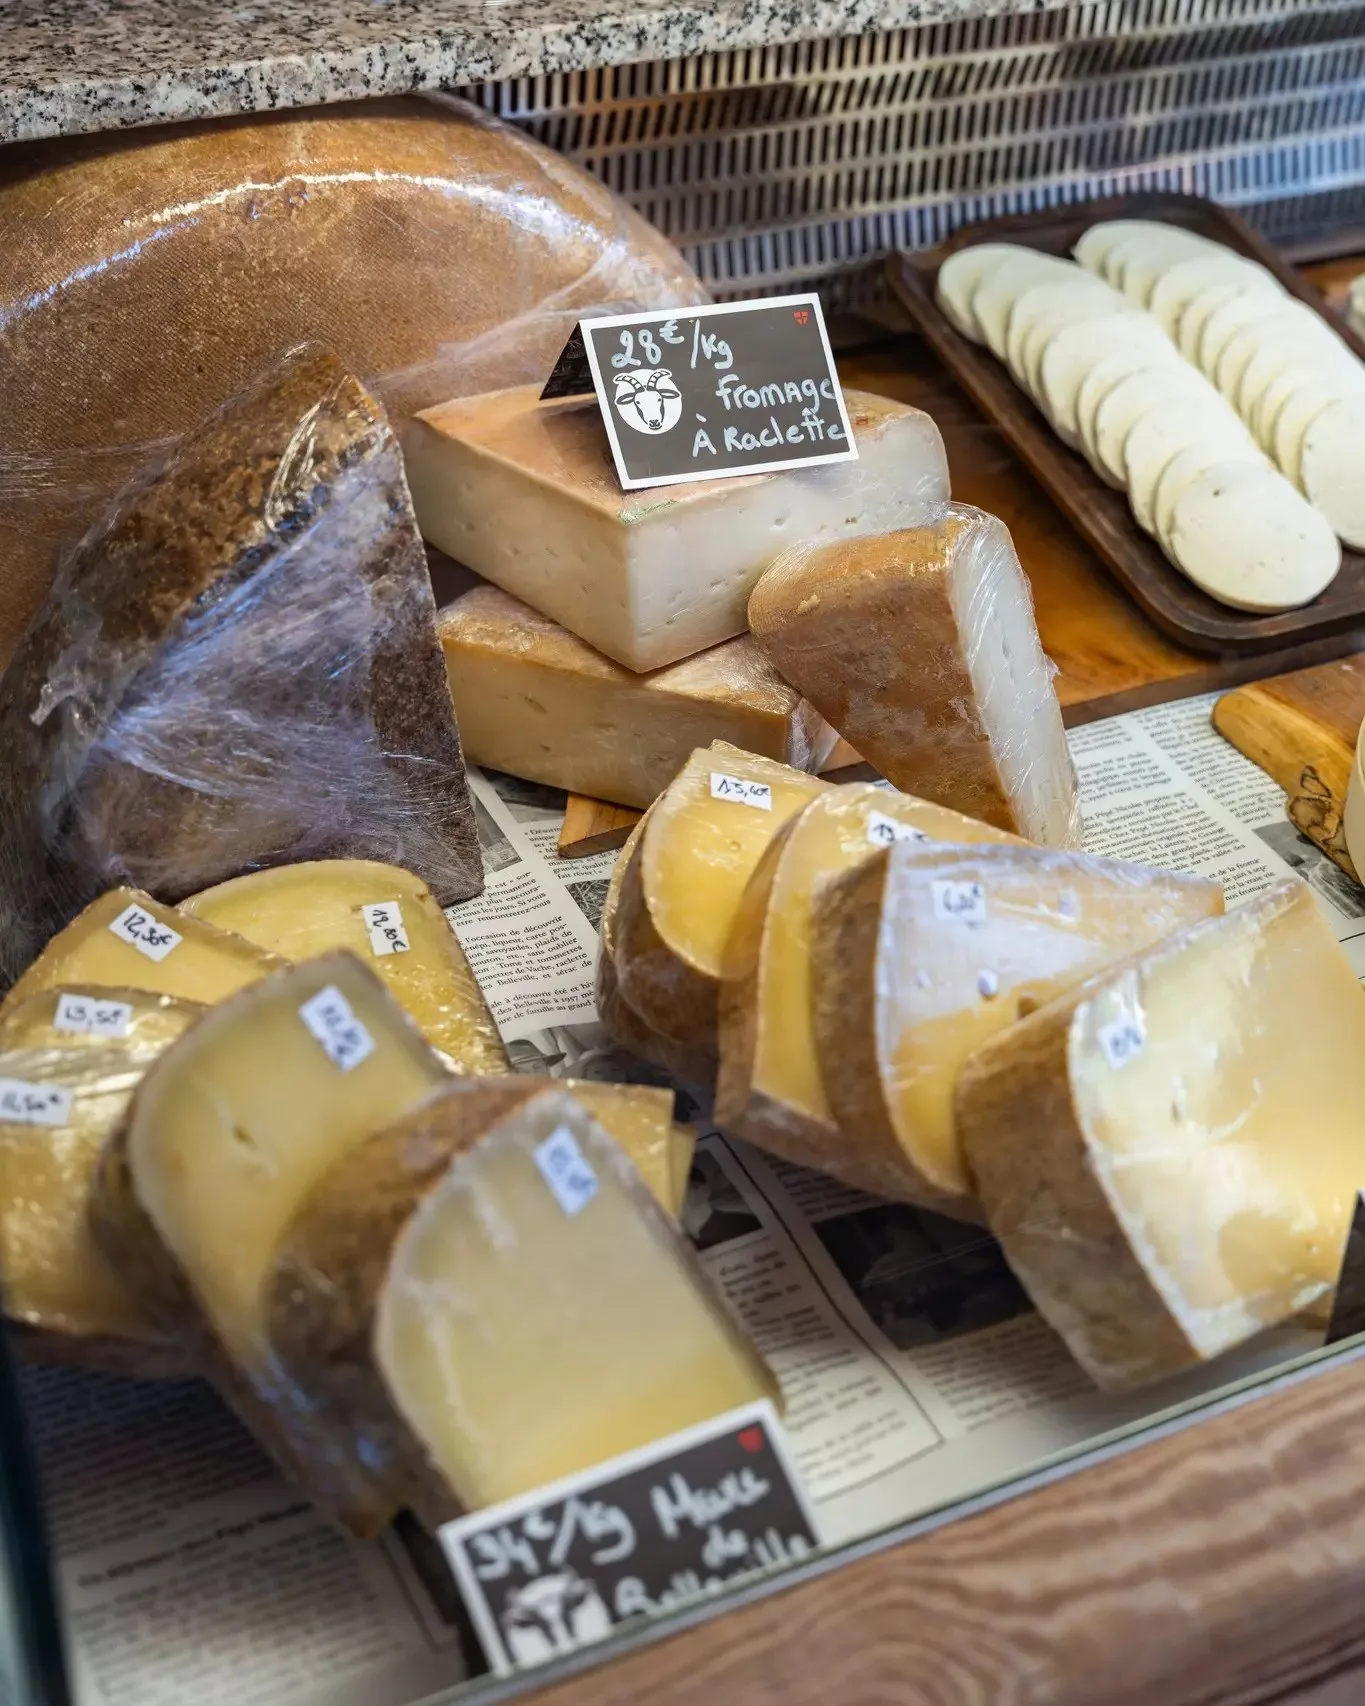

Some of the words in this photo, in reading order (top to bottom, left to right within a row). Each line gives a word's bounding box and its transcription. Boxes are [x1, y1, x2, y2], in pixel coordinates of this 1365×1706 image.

[723, 406, 847, 452] Raclette
[487, 878, 537, 899] permanence
[1224, 893, 1239, 901] nos
[451, 905, 470, 915] plus
[486, 897, 504, 907] plus
[462, 909, 482, 918] tous
[481, 906, 494, 914] les
[494, 903, 517, 913] jours.
[517, 899, 527, 907] Si
[526, 892, 547, 904] vous
[456, 918, 474, 927] être
[523, 915, 563, 934] découvrir
[464, 943, 491, 953] énépi,
[491, 937, 524, 948] liqueur,
[525, 931, 547, 942] carte
[467, 951, 483, 960] ion
[485, 944, 533, 956] savoyardes,
[534, 935, 560, 949] plaids
[561, 930, 573, 938] de
[527, 949, 545, 957] sans
[547, 937, 578, 953] oublier
[536, 944, 583, 964] tommettes
[478, 970, 514, 983] omettes
[514, 967, 525, 975] de
[526, 963, 555, 973] Vache,
[555, 952, 588, 968] raclette
[497, 974, 539, 986] Belleville,
[555, 965, 578, 977] sérac
[581, 959, 593, 968] de
[513, 990, 552, 1002] découvrir
[554, 988, 568, 996] été
[513, 998, 552, 1010] Belleville
[560, 994, 579, 1003] 1957
[526, 1005, 556, 1015] famille
[567, 999, 593, 1011] grand
